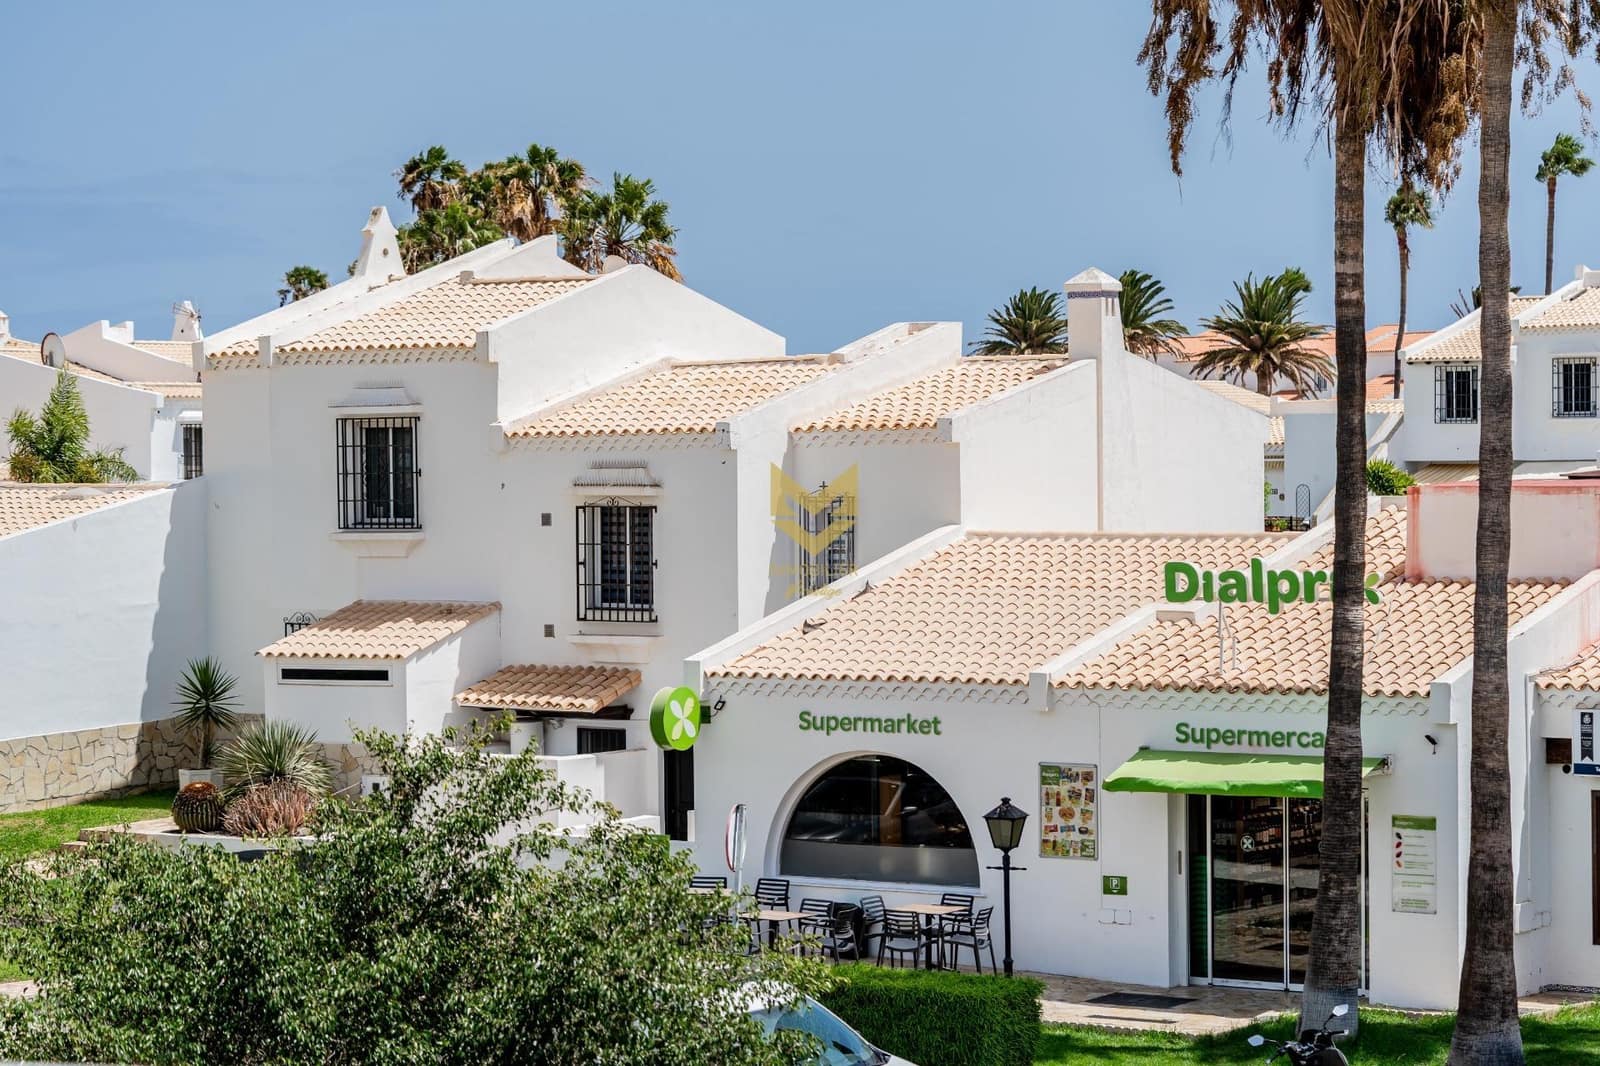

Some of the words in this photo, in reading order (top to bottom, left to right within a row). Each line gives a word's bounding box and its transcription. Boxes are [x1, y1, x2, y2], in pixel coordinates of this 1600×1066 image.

[1164, 557, 1380, 615] Dialpr
[798, 710, 942, 736] Supermarket
[1175, 722, 1328, 749] Supermerca
